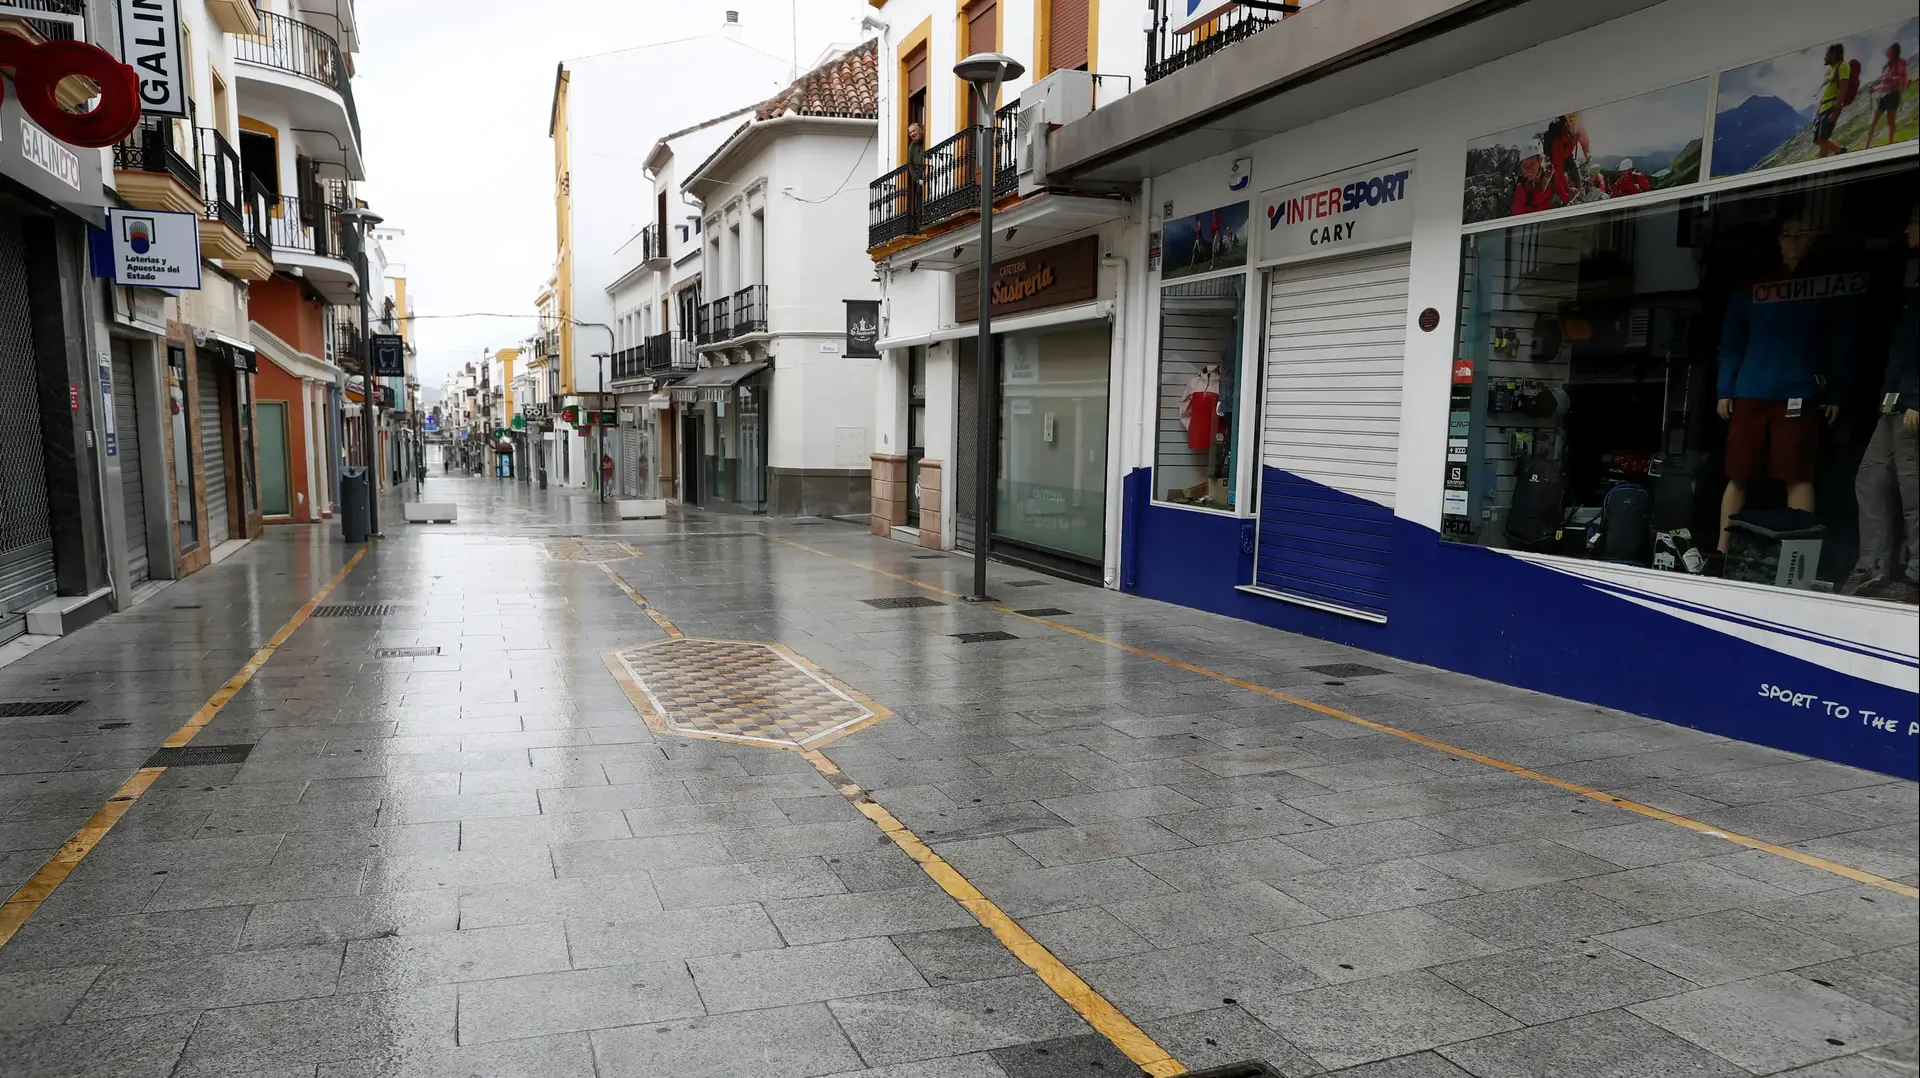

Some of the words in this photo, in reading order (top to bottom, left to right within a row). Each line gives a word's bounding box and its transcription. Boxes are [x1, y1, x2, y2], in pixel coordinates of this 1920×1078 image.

[21, 122, 79, 187] GALINDO
[1163, 203, 1173, 217] 79
[1287, 170, 1409, 225] INTERSPORT
[1310, 221, 1356, 246] CARY
[125, 254, 160, 264] Loterías
[161, 258, 167, 266] y
[127, 264, 166, 272] Apuestas
[167, 265, 180, 274] del
[127, 272, 156, 280] Estado
[992, 262, 1054, 304] Sastrería
[1444, 518, 1475, 535] PETZL
[1786, 551, 1798, 586] UNEEK
[1758, 683, 1818, 709] SPORT
[1822, 700, 1850, 719] TO
[1858, 710, 1899, 733] THE
